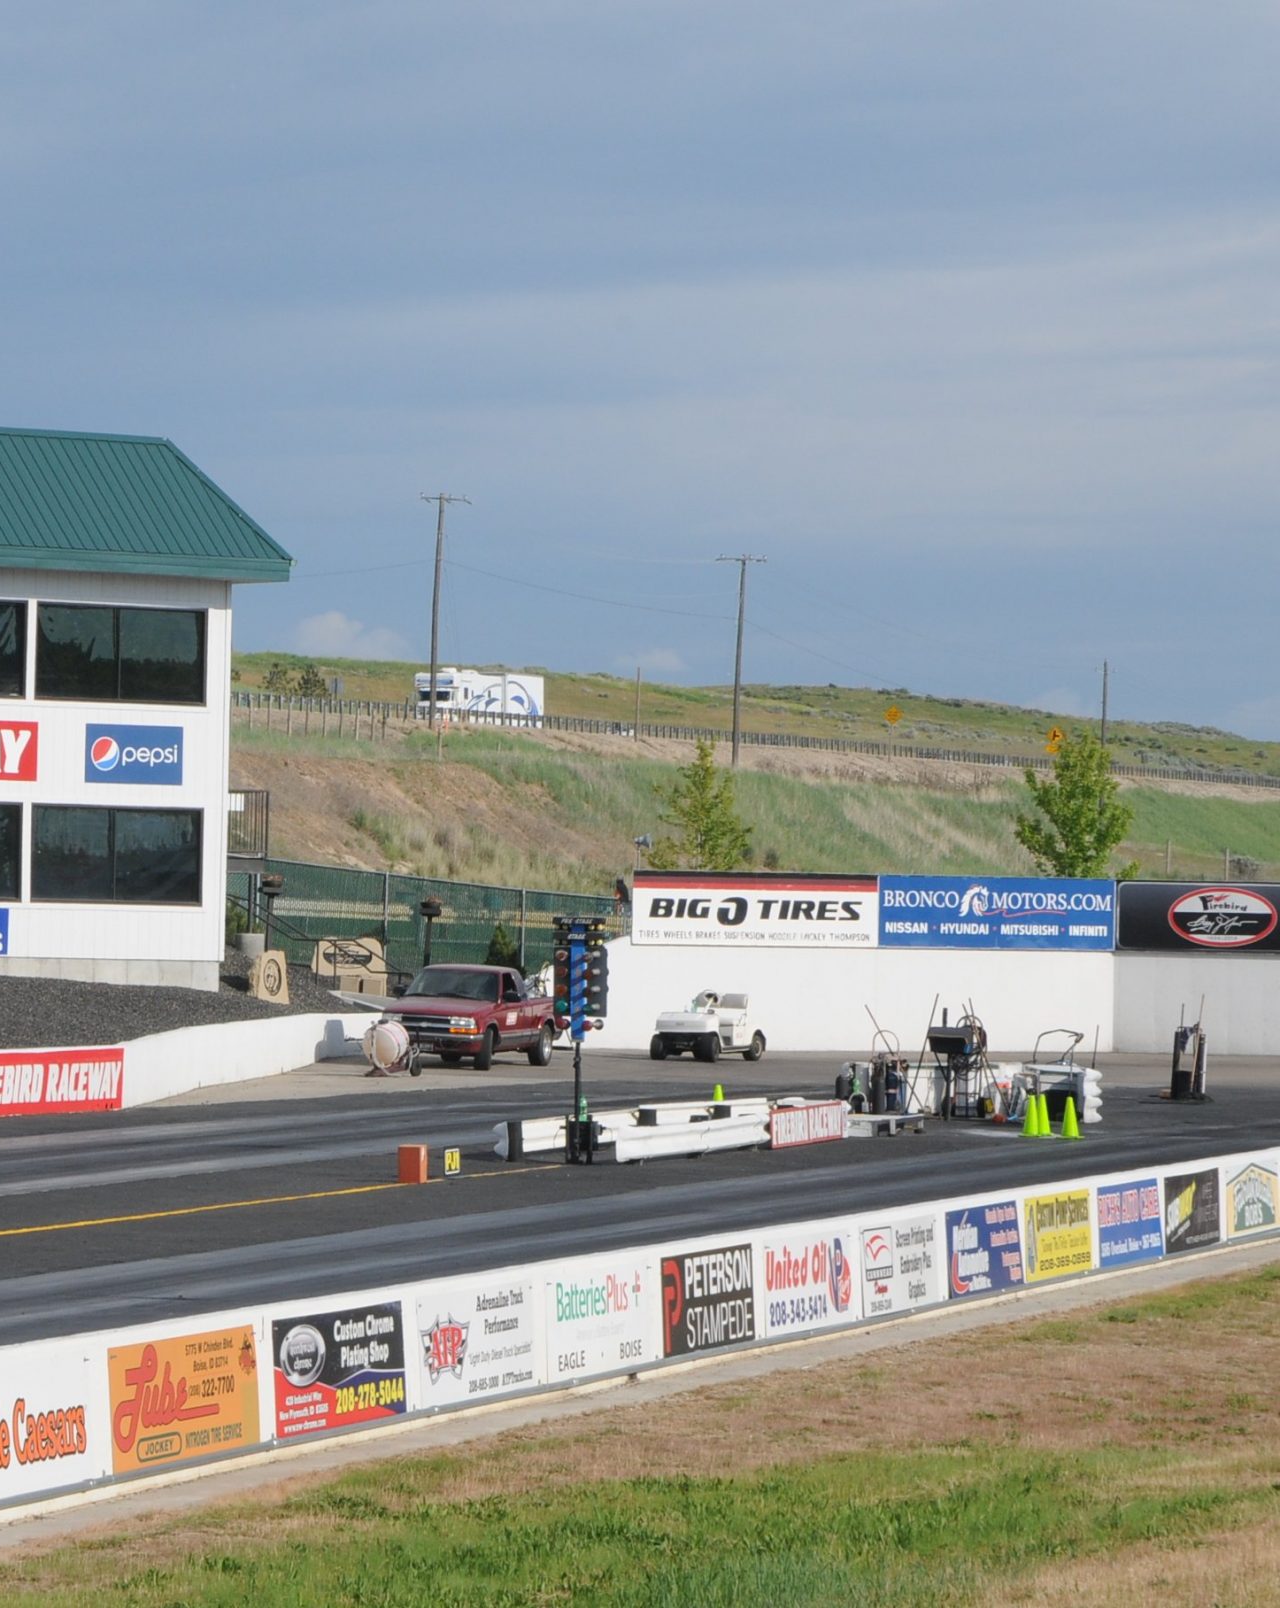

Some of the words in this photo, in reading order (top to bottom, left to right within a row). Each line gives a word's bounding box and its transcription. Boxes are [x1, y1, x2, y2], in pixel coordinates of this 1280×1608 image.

[122, 743, 178, 767] pepsi
[649, 897, 713, 919] BIG
[756, 899, 863, 921] TIRES
[883, 890, 959, 908] BRONCO
[992, 892, 1112, 912] MOTORS.COM
[885, 921, 928, 934] NISSAN
[940, 923, 990, 936] HYUNDAI
[1000, 924, 1059, 937] MITSUBISHI
[1069, 925, 1108, 938] INFINITI
[45, 1060, 122, 1103] RACEWAY
[684, 1248, 752, 1300] PETERSON
[765, 1245, 808, 1292] United
[811, 1240, 828, 1285] Oil
[476, 1291, 509, 1312] Adrenaline
[769, 1293, 828, 1328] 208-343-5474
[333, 1319, 365, 1342] Custom
[365, 1314, 395, 1337] Chrome
[484, 1315, 519, 1335] Performance
[686, 1297, 753, 1349] STAMPEDE
[340, 1343, 369, 1368] Plating
[369, 1340, 390, 1363] Shop
[430, 1326, 463, 1370] ATP
[558, 1350, 586, 1372] EAGLE
[619, 1339, 642, 1360] BOISE
[201, 1374, 235, 1398] 322-7700
[335, 1376, 405, 1415] 208-278-5044
[11, 1396, 88, 1464] Caesars
[145, 1438, 175, 1456] JOCKEY
